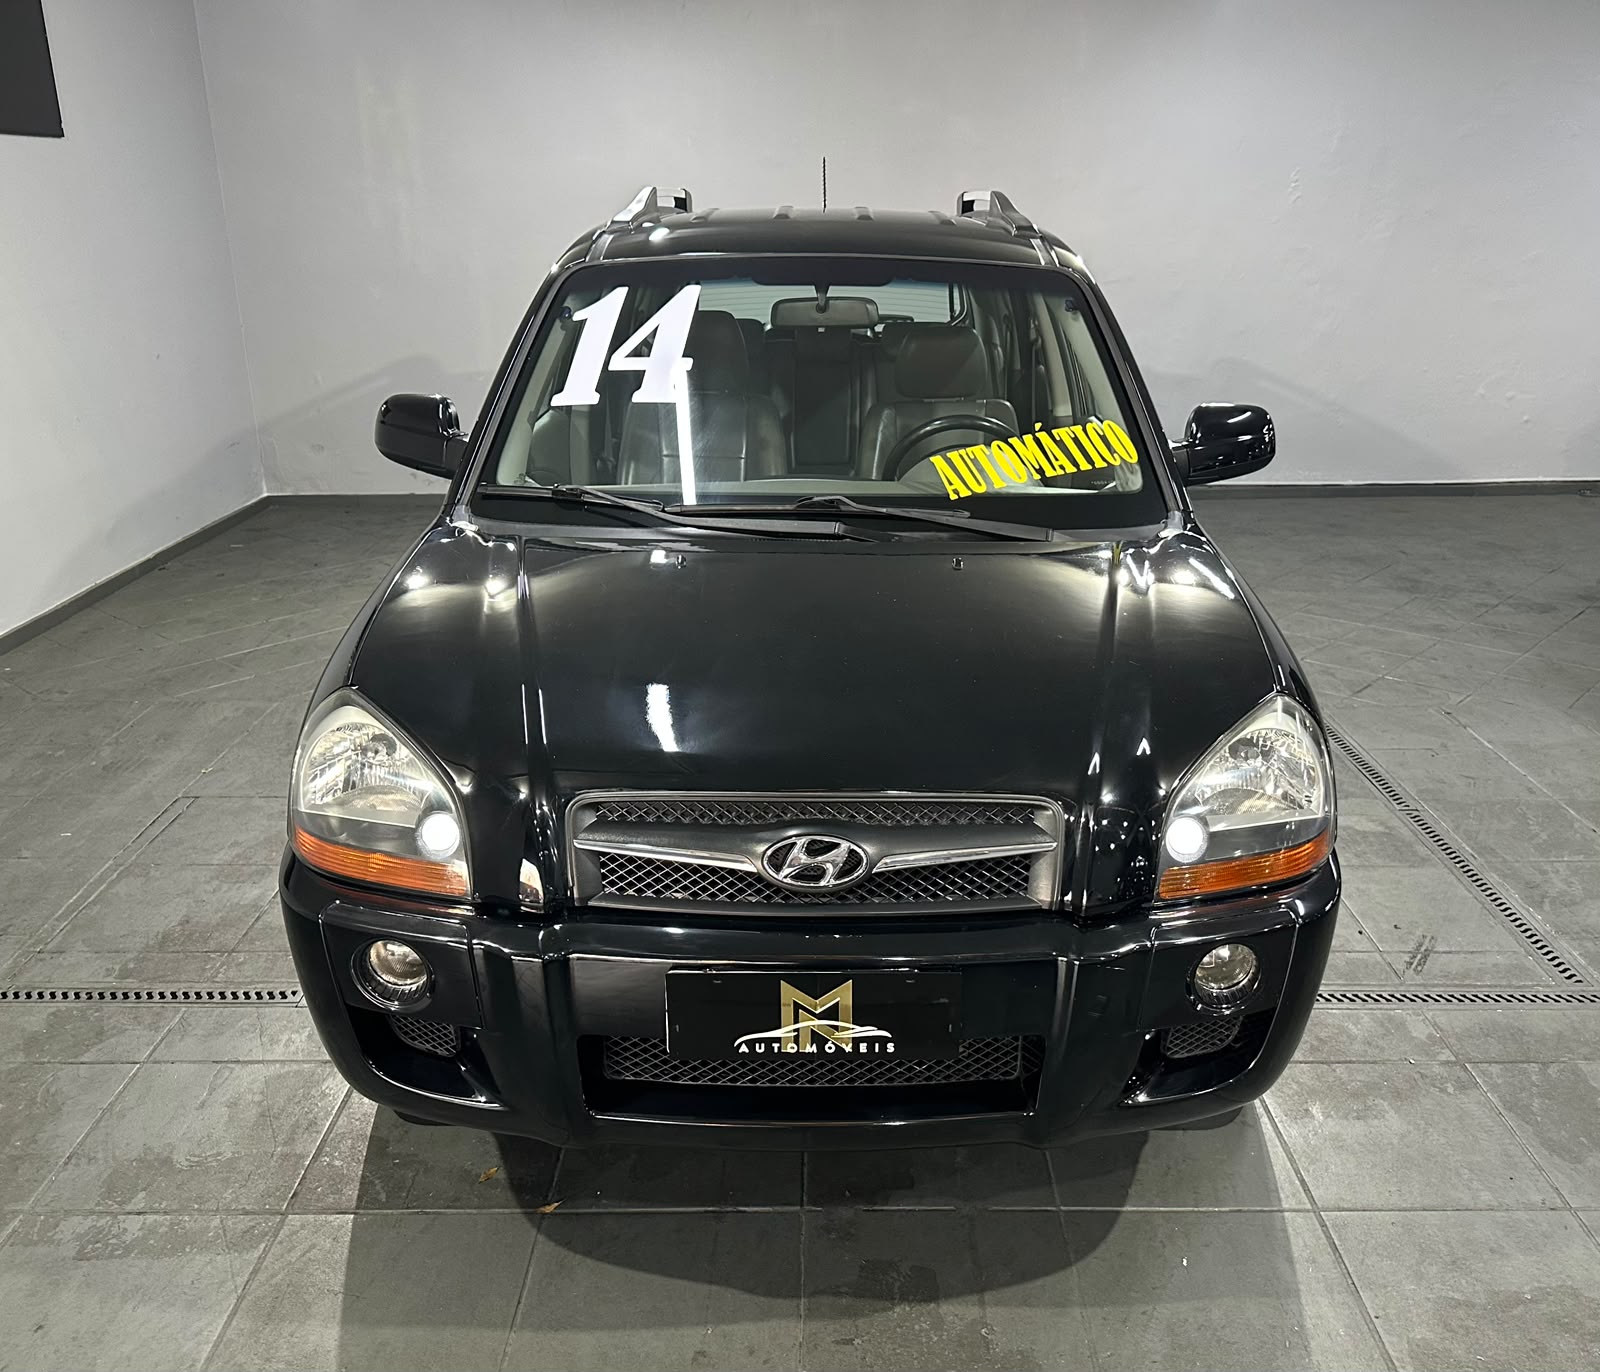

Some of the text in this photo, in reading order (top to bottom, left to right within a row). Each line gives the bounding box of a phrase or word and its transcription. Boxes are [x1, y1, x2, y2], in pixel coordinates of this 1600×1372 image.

[550, 284, 702, 407] 14
[930, 419, 1139, 501] AUTOMÁTICO
[738, 1041, 896, 1054] AUTOMÓVEIS
